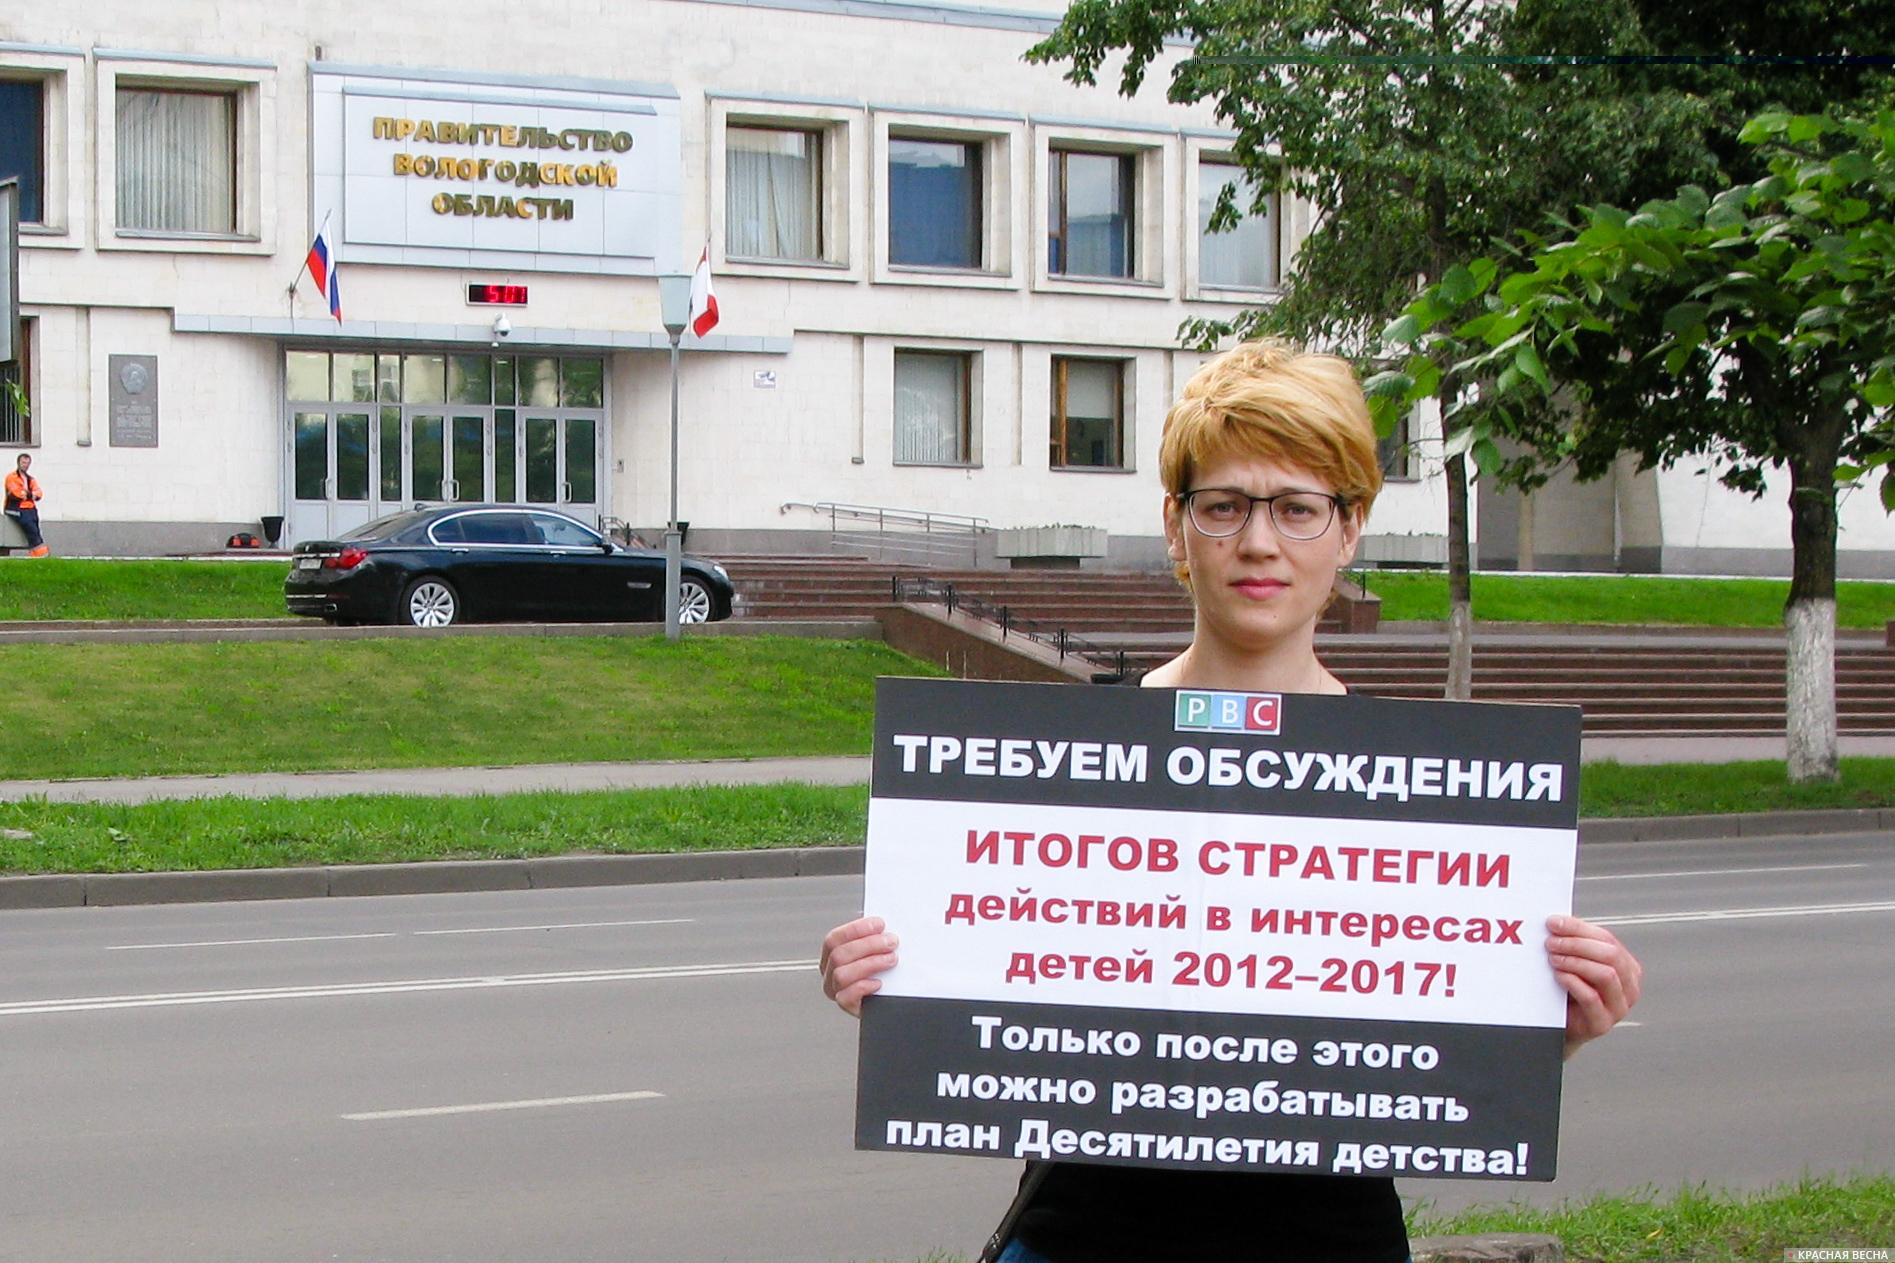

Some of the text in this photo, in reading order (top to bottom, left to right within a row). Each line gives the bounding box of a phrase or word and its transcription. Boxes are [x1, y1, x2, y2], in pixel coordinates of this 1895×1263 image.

[372, 117, 633, 152] ПРАВИТЕЛЬСТВО
[393, 153, 618, 187] ВОЛОГОДСКОЙ
[432, 192, 574, 221] ОБЛАСТИ
[894, 735, 1562, 801] ТРЕБУЕМ ОБСУЖДЕНИЯ
[966, 830, 1510, 888] ИТОГОВ СТРАТЕГИИ
[944, 889, 1521, 948] действий в интересах
[1006, 950, 1153, 984] детей
[972, 1016, 1438, 1070] Только после этого
[938, 1073, 1468, 1121] можно разрабатывать
[886, 1119, 1528, 1175] план Десятилетия детства!
